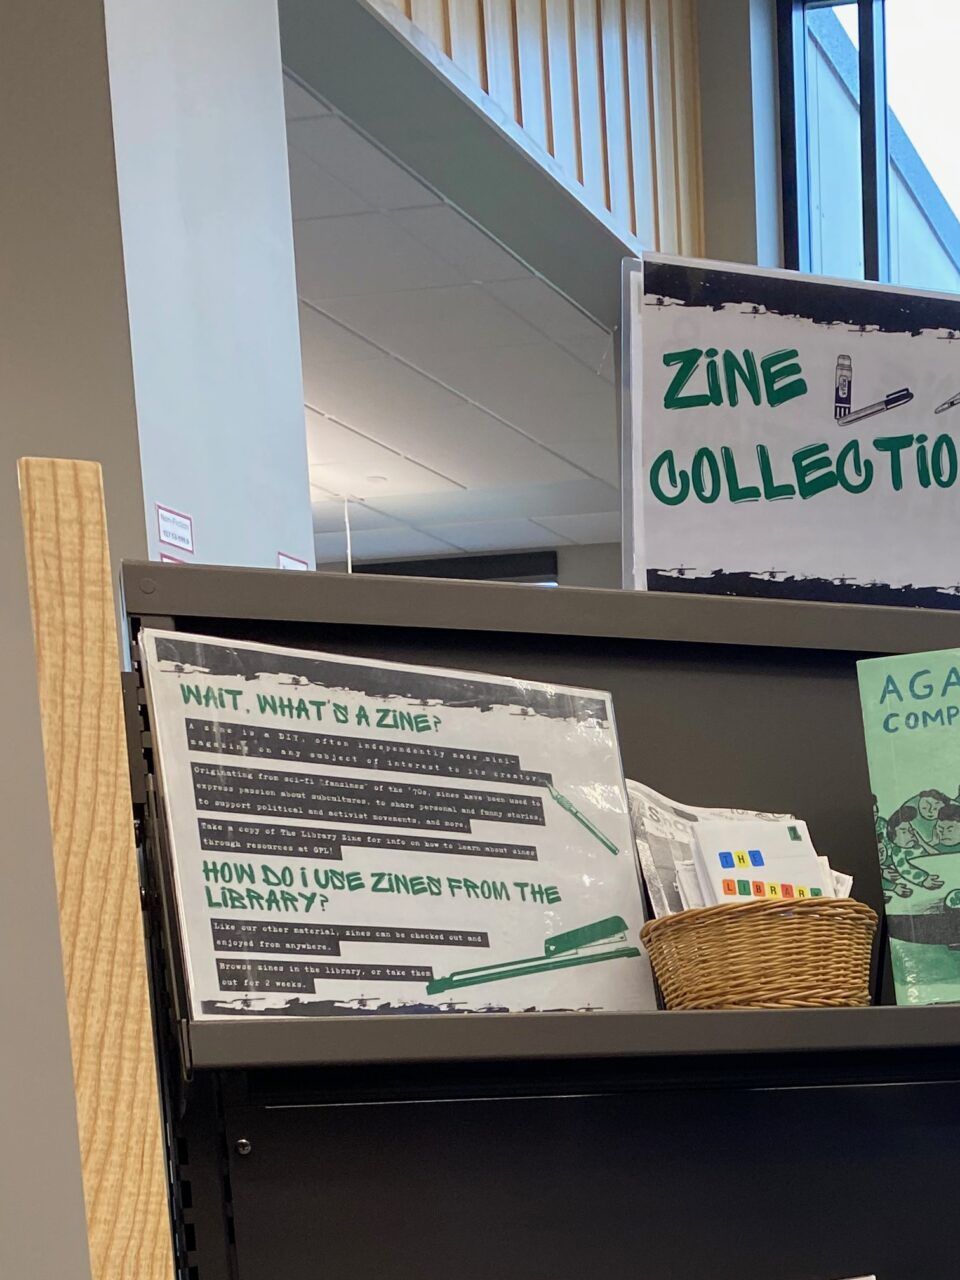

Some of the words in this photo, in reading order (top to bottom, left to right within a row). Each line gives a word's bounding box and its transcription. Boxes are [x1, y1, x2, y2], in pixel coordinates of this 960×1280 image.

[355, 705, 371, 727] A
[201, 822, 223, 831] Take
[240, 826, 260, 836] copy
[280, 829, 296, 837] The
[300, 831, 337, 841] Library
[367, 836, 381, 844] for
[386, 838, 406, 846] info
[424, 840, 440, 848] how
[203, 838, 242, 848] through
[246, 842, 294, 852] resources
[721, 852, 762, 867] THE
[202, 860, 256, 884] HOW
[261, 864, 294, 887] DO
[313, 867, 366, 891] USE
[446, 876, 511, 901] FROM
[513, 881, 562, 905] THE
[214, 922, 235, 931] Like
[262, 924, 289, 933] other
[293, 927, 340, 936] material,
[345, 929, 371, 937] zines
[375, 930, 391, 938] can
[395, 930, 406, 938] be
[410, 931, 444, 940] checked
[449, 932, 463, 941] out
[467, 934, 483, 942] and
[216, 939, 254, 949] enjoyed
[260, 940, 281, 948] from
[285, 941, 332, 951] anywhere.
[219, 962, 252, 970] Browse
[257, 964, 284, 972] zines
[289, 964, 300, 972] in
[304, 965, 321, 973] the
[325, 966, 365, 977] library,
[386, 968, 406, 977] take
[410, 969, 432, 977] them
[244, 979, 260, 987] for
[275, 980, 307, 988] weeks.
